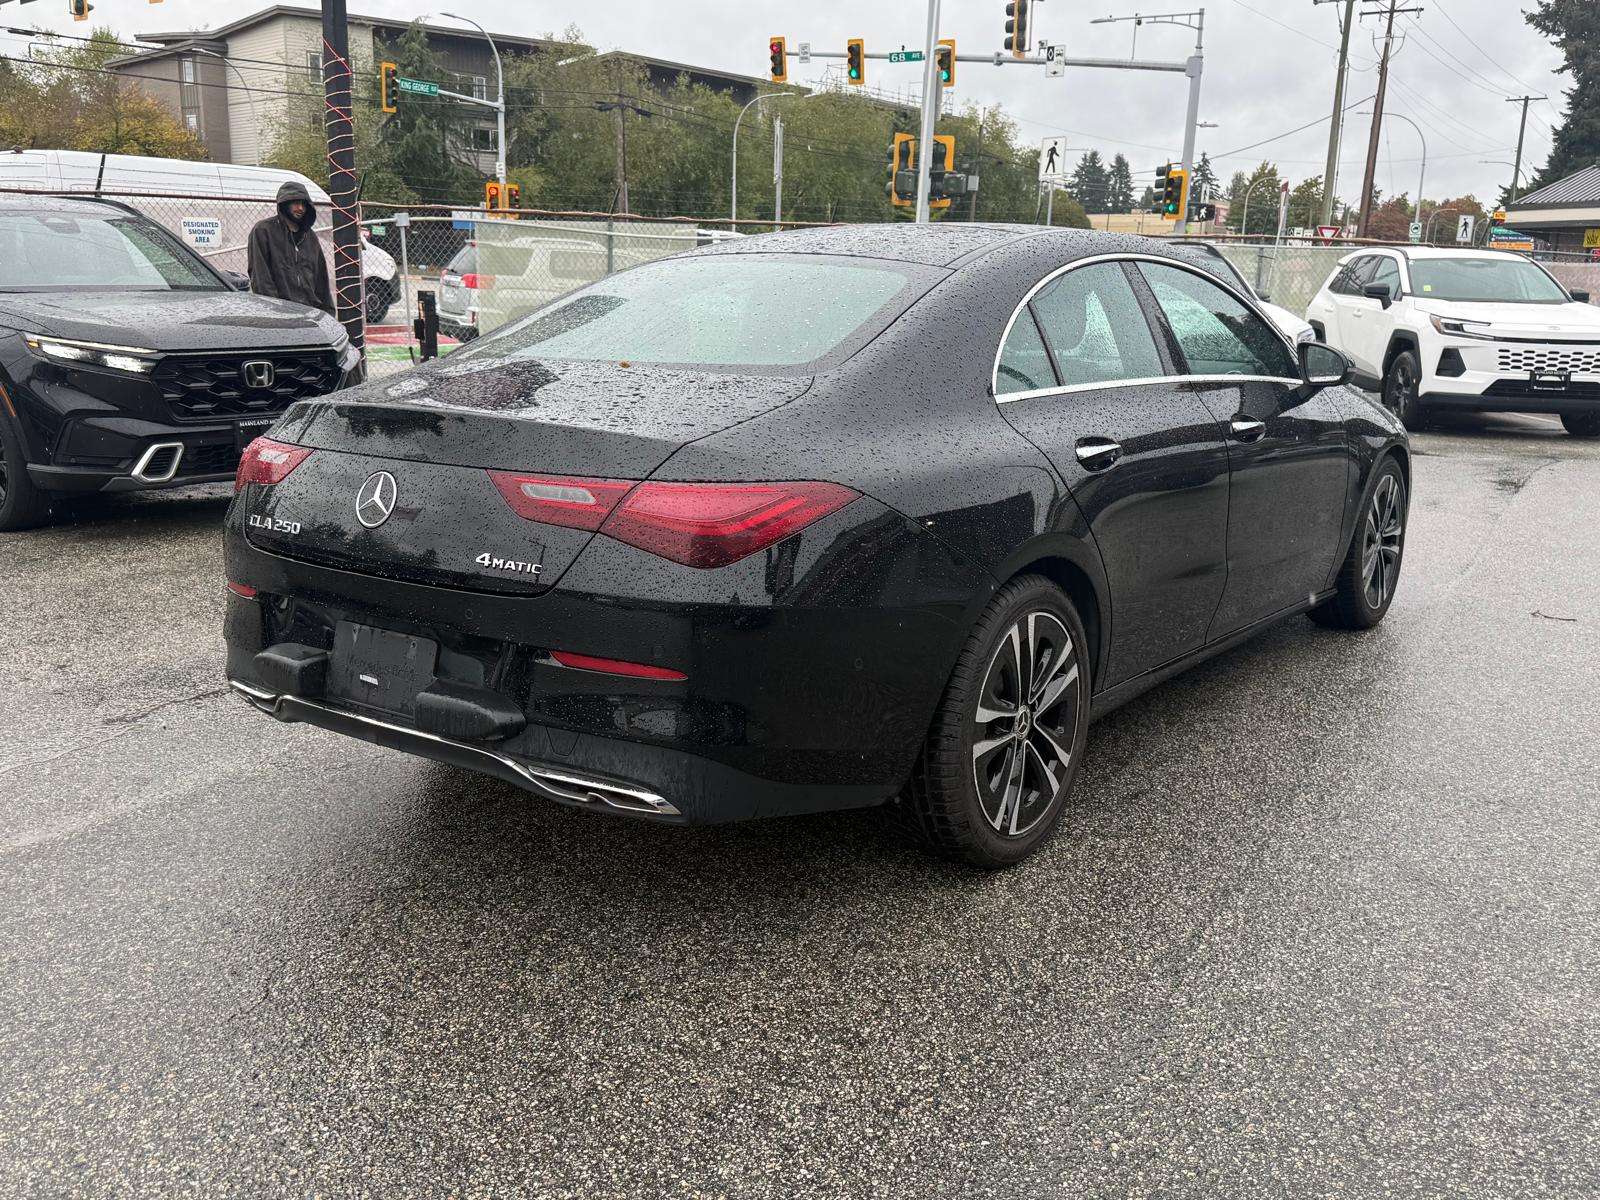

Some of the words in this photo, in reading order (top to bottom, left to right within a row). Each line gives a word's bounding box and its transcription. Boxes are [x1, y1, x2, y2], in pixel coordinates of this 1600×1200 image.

[891, 53, 906, 62] 68
[401, 80, 411, 90] KING
[412, 82, 430, 92] GEORGE
[239, 419, 269, 427] MAINLAND
[249, 514, 272, 530] CLA
[273, 519, 301, 535] 250
[475, 552, 543, 574] 4MATIC
